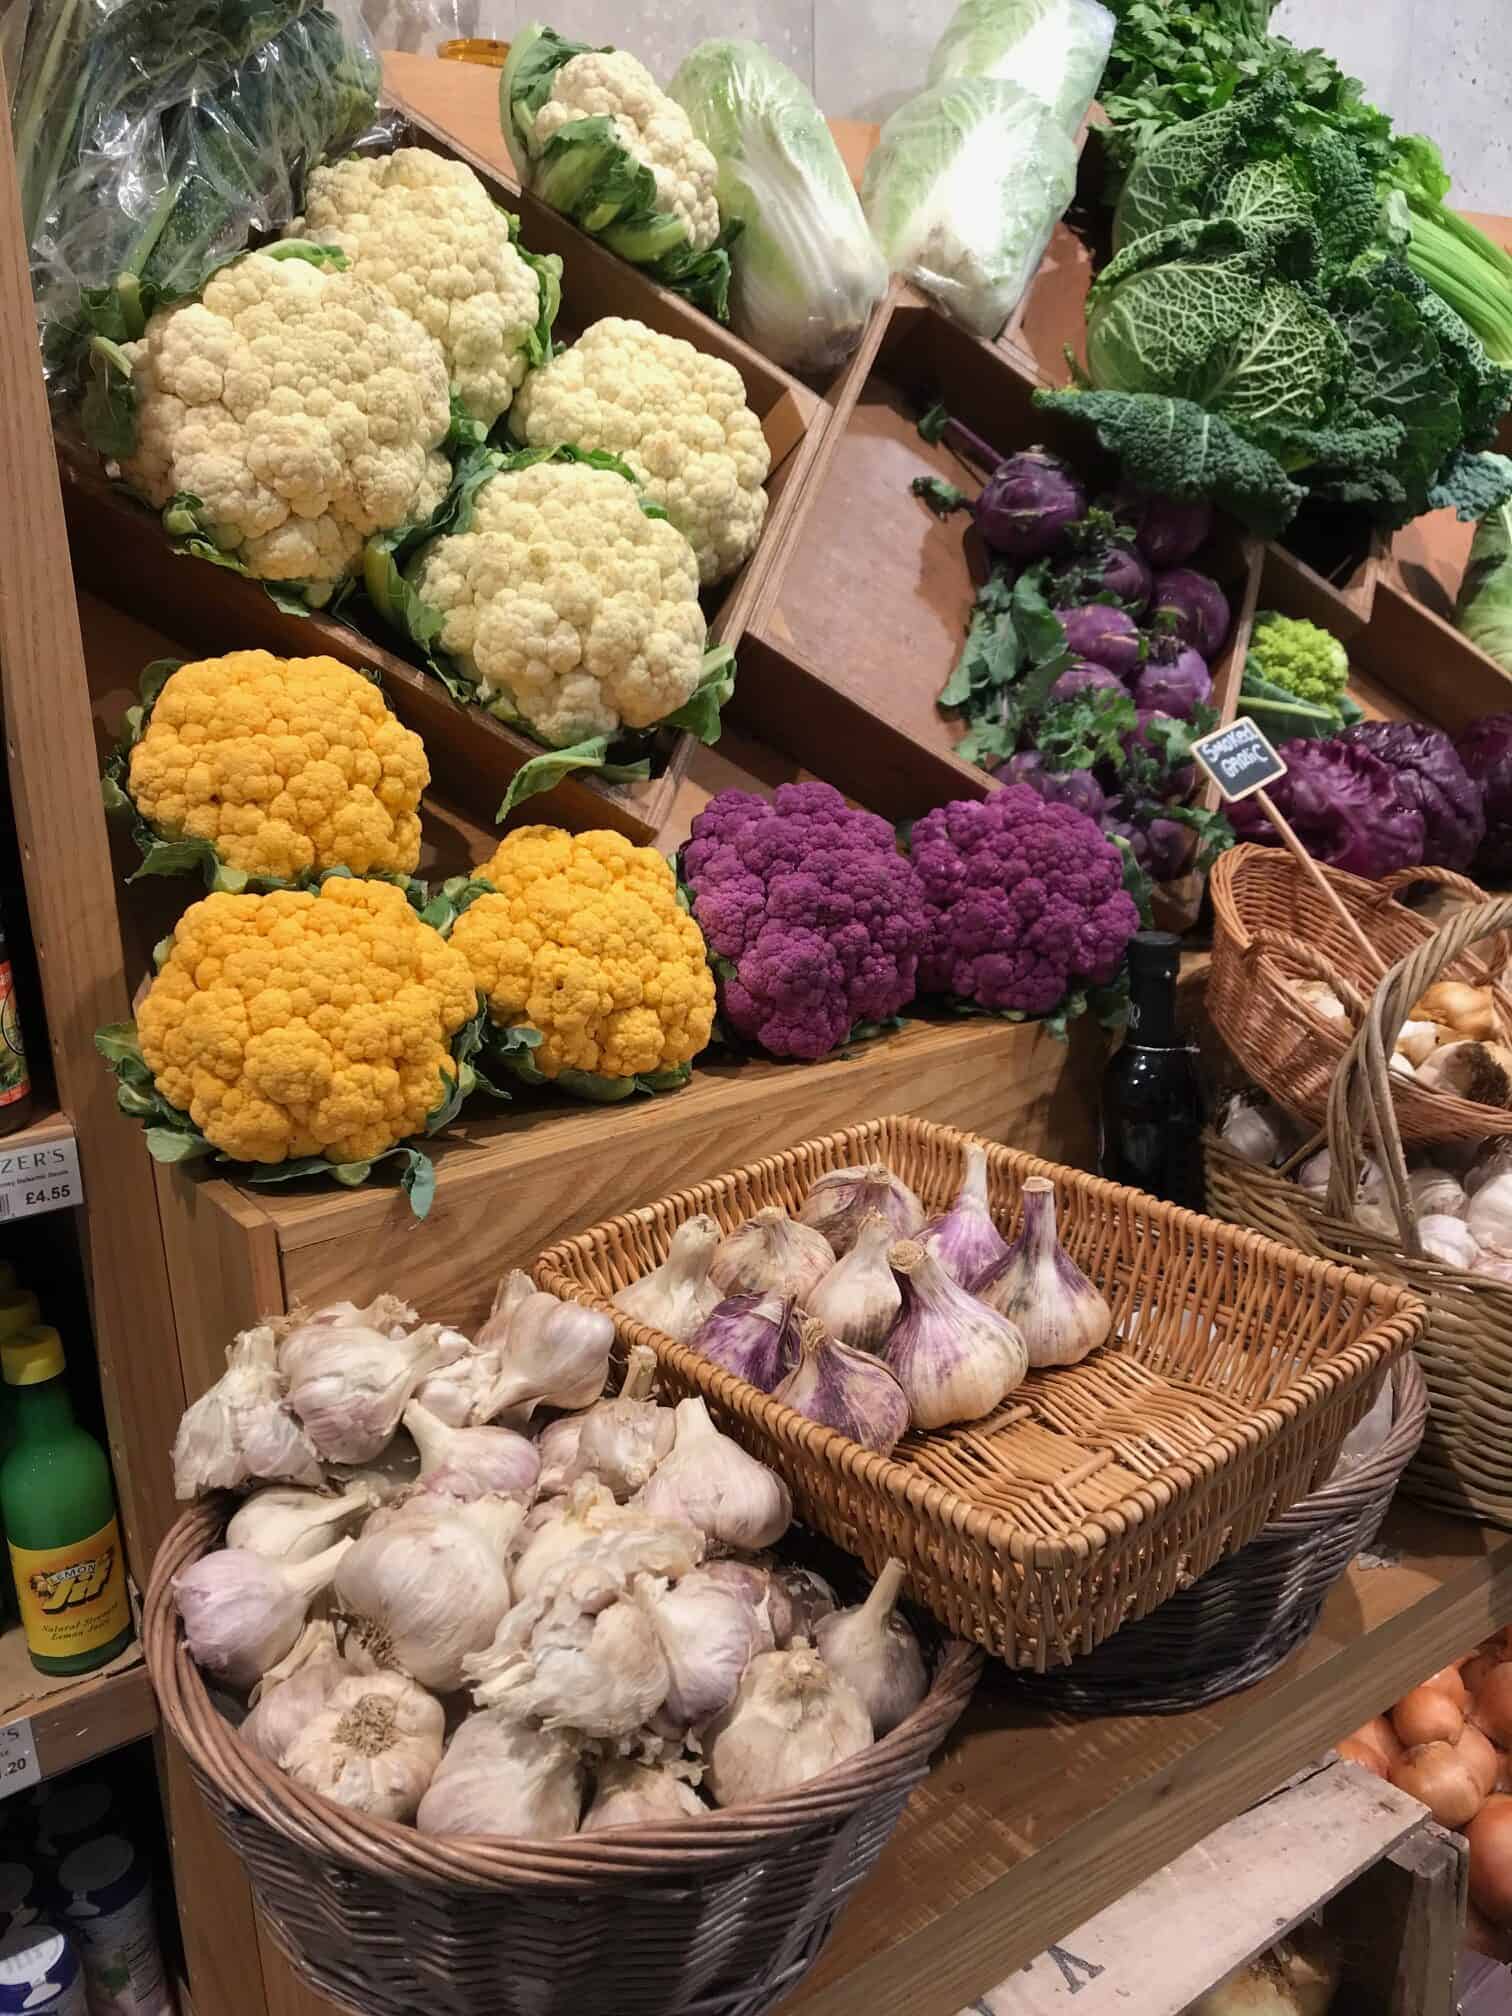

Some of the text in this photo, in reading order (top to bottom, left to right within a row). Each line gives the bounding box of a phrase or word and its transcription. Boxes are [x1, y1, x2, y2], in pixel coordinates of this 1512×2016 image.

[25, 1184, 71, 1205] £4.55
[48, 1562, 97, 1585] LEMON
[42, 1619, 80, 1633] Natural
[51, 1630, 83, 1641] Lemon
